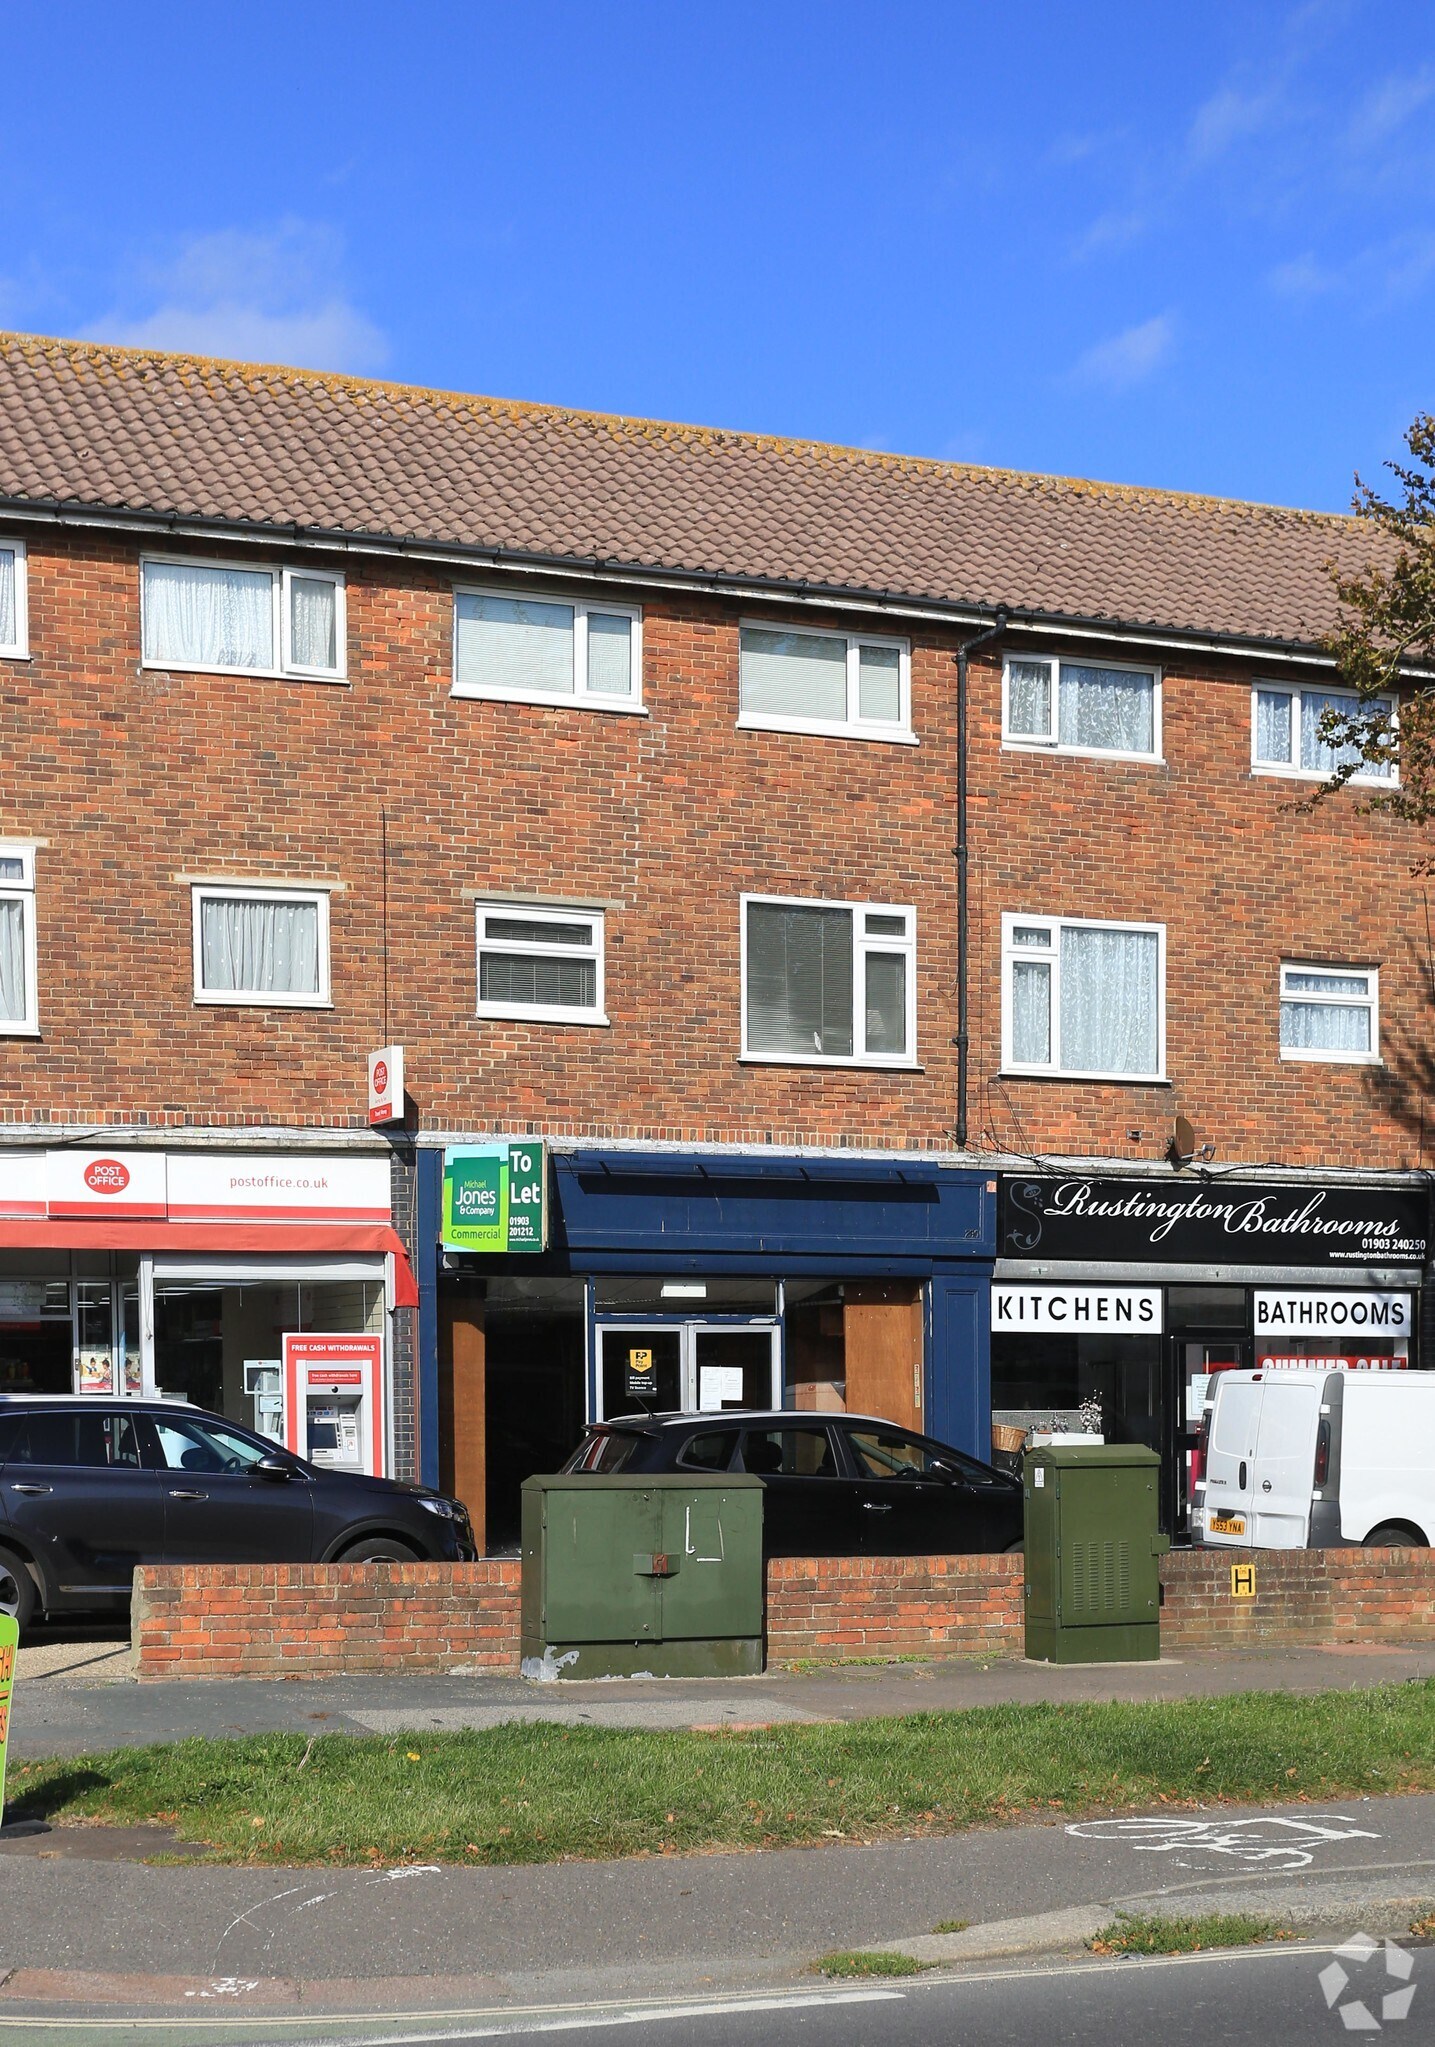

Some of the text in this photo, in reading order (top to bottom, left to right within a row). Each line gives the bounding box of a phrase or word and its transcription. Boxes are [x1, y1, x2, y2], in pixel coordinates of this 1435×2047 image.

[374, 1076, 387, 1088] OFFICE
[510, 1150, 532, 1172] To
[94, 1165, 121, 1176] POST
[88, 1175, 125, 1187] OFFICE
[230, 1176, 328, 1189] postoffice.co.uk
[464, 1180, 487, 1189] Michael
[455, 1186, 496, 1205] Jones
[511, 1182, 541, 1204] Let
[1043, 1181, 1401, 1243] Rustington Bathrooms
[509, 1216, 530, 1226] 01903
[451, 1228, 501, 1240] Commercial
[509, 1226, 534, 1236] 201212
[1361, 1238, 1426, 1250] 01903 240250
[1329, 1251, 1426, 1260] www.rustingtonbathrooms.co.uk
[998, 1296, 1154, 1322] KITCHENS
[1258, 1300, 1405, 1325] BATHROOMS
[1229, 1521, 1242, 1533] YNA
[1235, 1568, 1252, 1594] H
